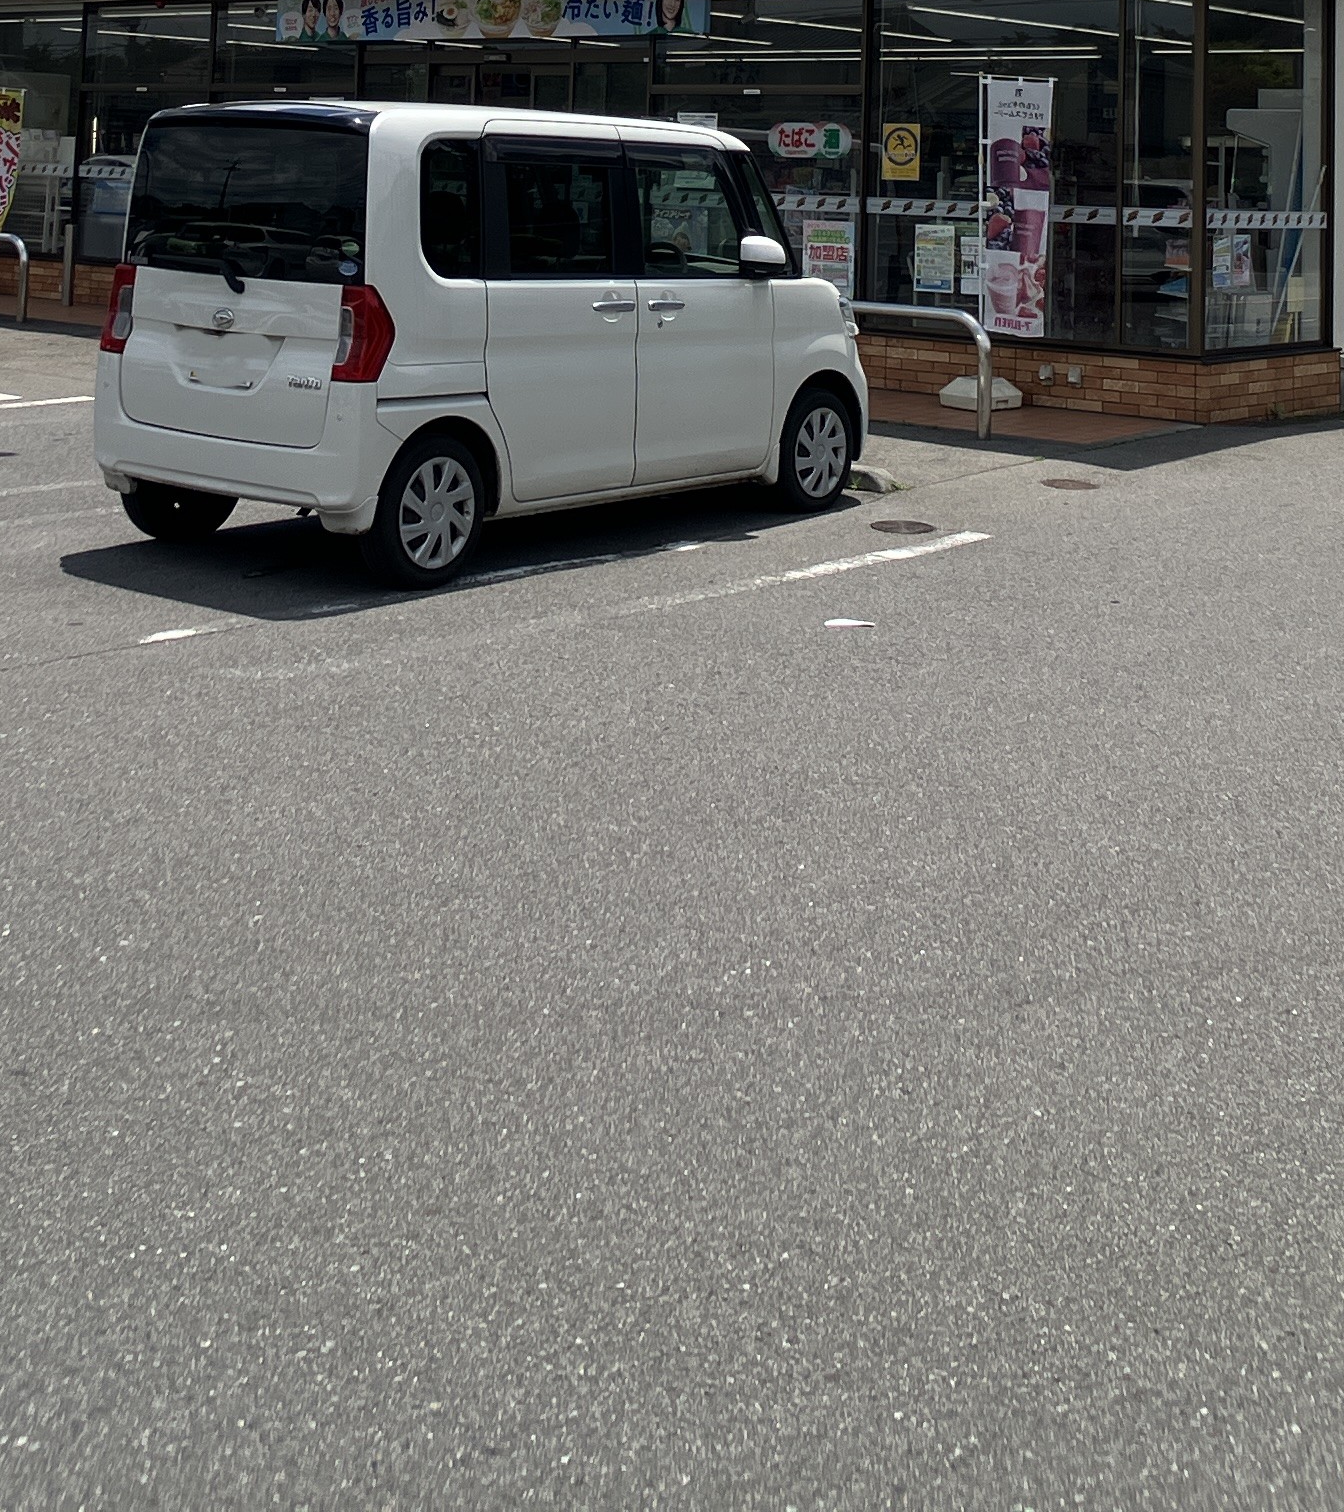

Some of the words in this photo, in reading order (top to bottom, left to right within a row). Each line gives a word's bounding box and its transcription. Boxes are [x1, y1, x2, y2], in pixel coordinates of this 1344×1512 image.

[777, 127, 817, 148] たばこ
[808, 244, 850, 263] 加盟店
